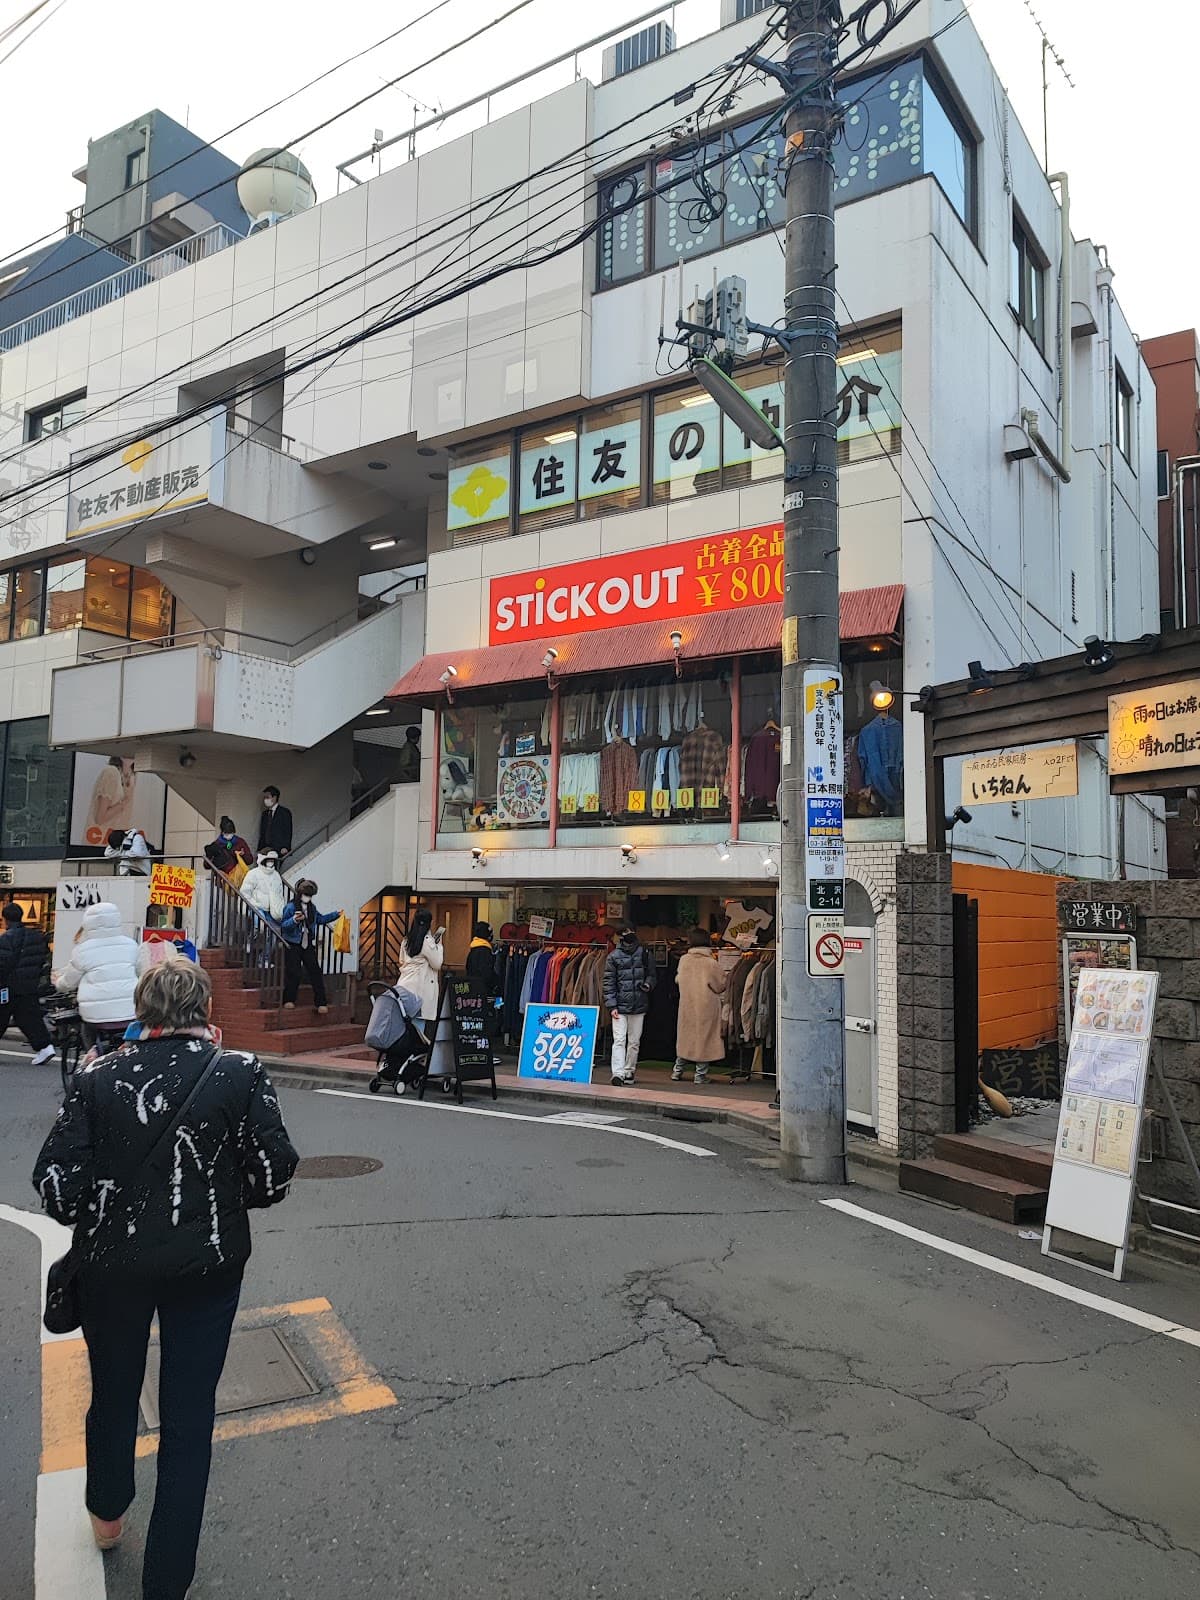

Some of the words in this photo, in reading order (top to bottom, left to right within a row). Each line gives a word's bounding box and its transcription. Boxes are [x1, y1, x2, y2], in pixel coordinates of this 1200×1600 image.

[532, 375, 883, 499] 住友の介
[77, 464, 200, 522] 住友不動産販売
[696, 529, 784, 570] 古着全品
[1133, 695, 1200, 724] 雨の日はお席
[972, 774, 1032, 800] いちねん
[818, 896, 840, 906] 2-14
[1071, 902, 1122, 929] 営業中
[533, 1032, 583, 1059] 50%
[533, 1056, 576, 1074] OFF
